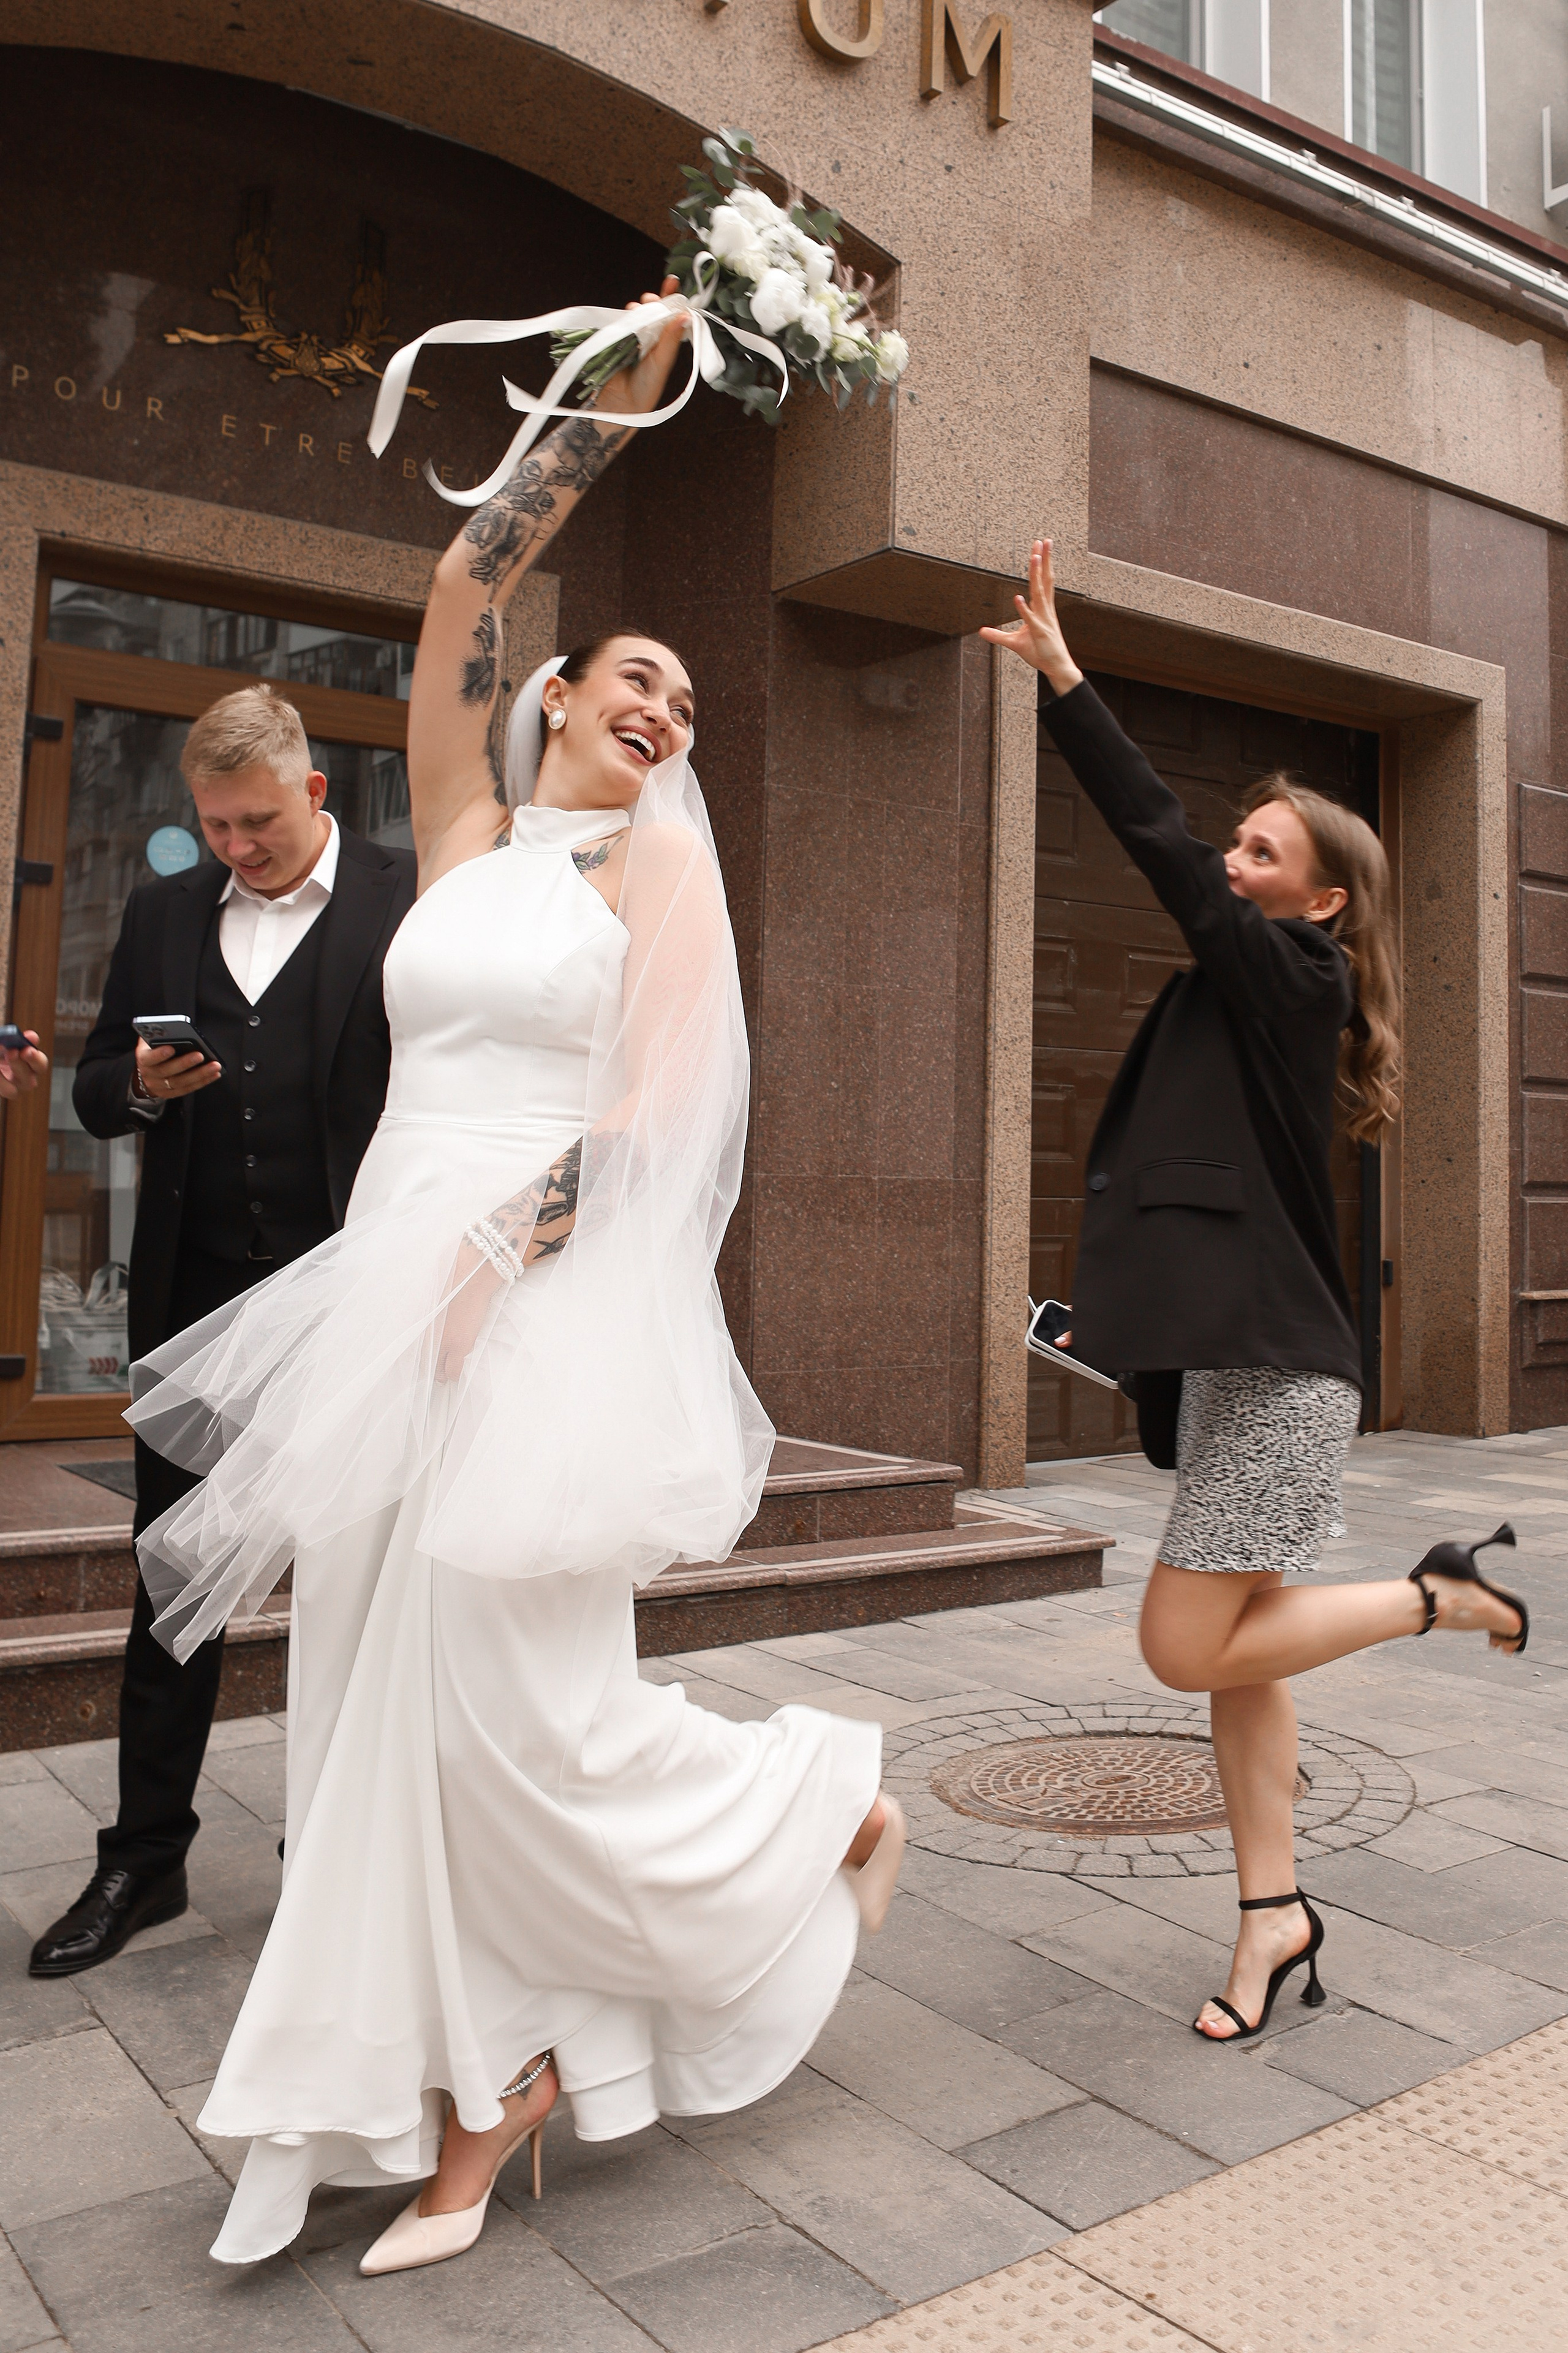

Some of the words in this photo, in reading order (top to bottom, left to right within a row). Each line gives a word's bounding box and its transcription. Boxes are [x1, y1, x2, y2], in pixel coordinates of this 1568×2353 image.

[704, 0, 1014, 127] UM
[12, 363, 164, 421] POUR
[221, 412, 352, 464] ETRE
